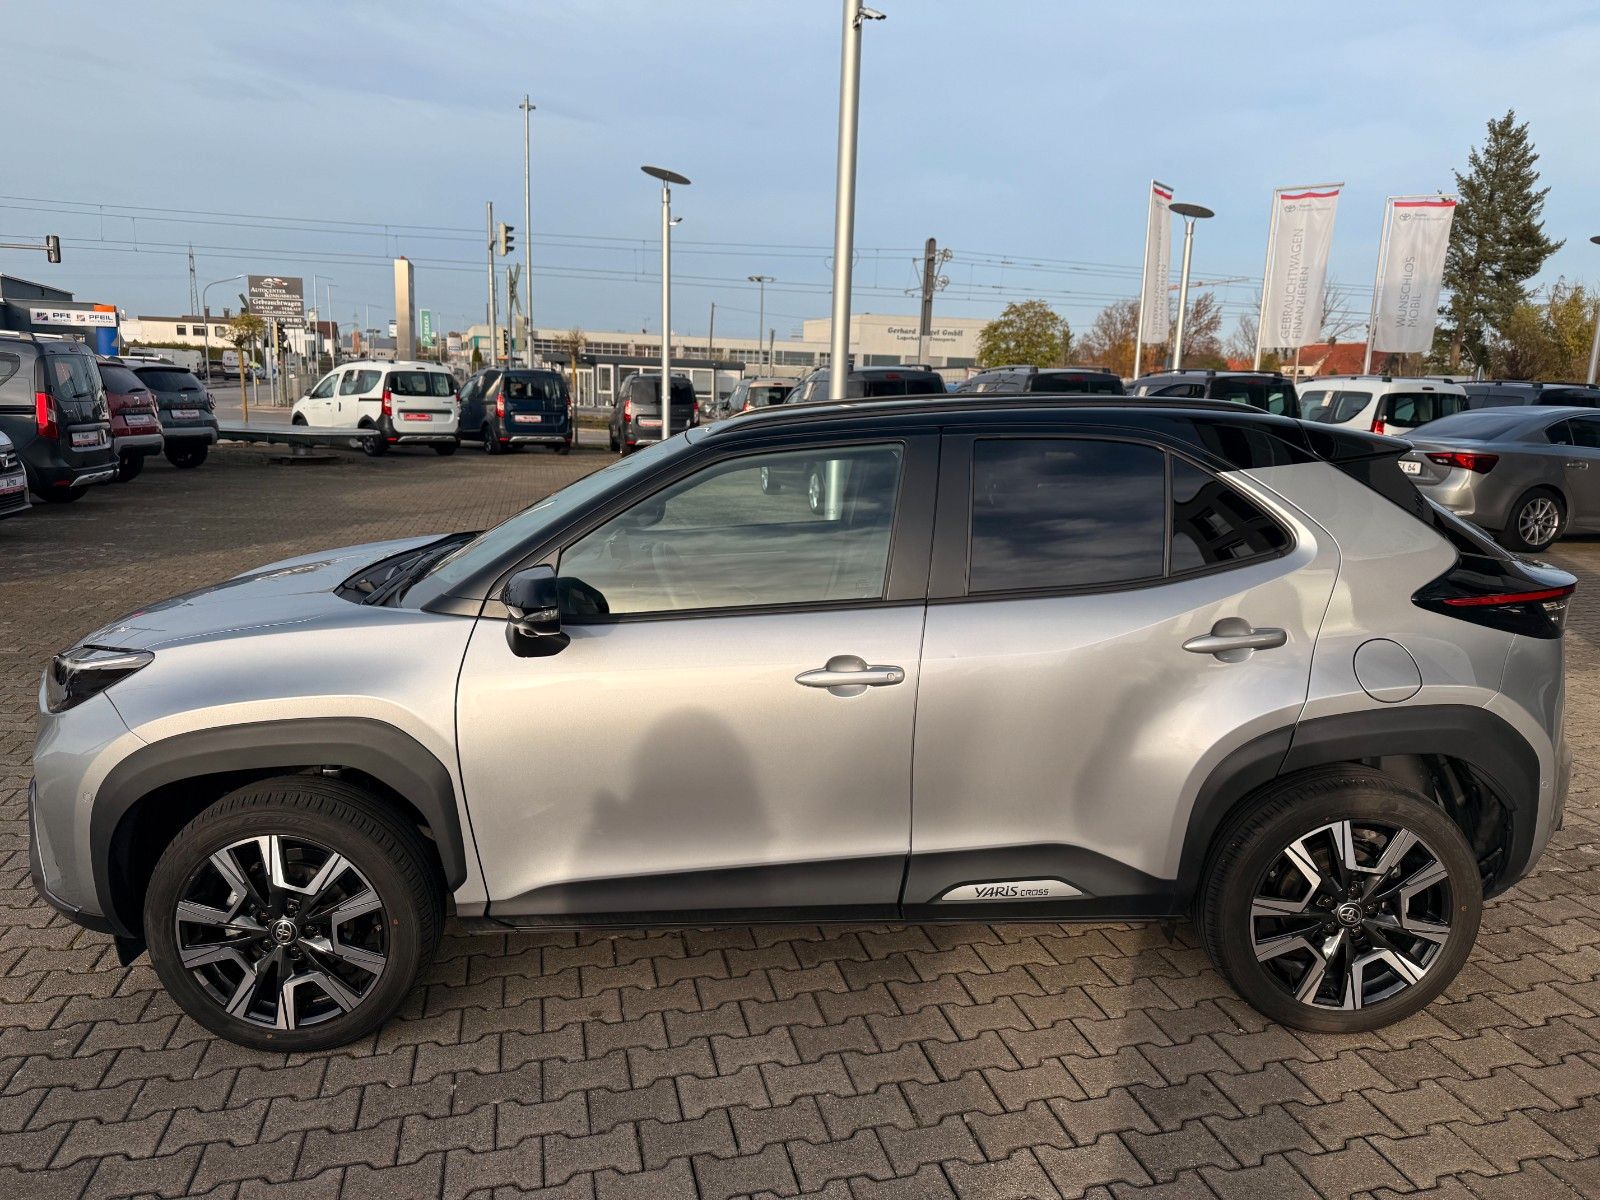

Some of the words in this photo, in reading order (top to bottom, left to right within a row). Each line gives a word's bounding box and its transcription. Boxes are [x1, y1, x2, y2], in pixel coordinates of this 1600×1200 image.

[1280, 228, 1304, 339] GEBRAUCHTWAGEN
[1292, 265, 1310, 339] FINANZIEREN
[1396, 256, 1416, 328] WUNSCHLOS
[1408, 292, 1421, 328] MOBIL
[887, 326, 917, 334] Gerhard
[974, 885, 1019, 898] YARIS
[1020, 888, 1049, 897] CROSS
